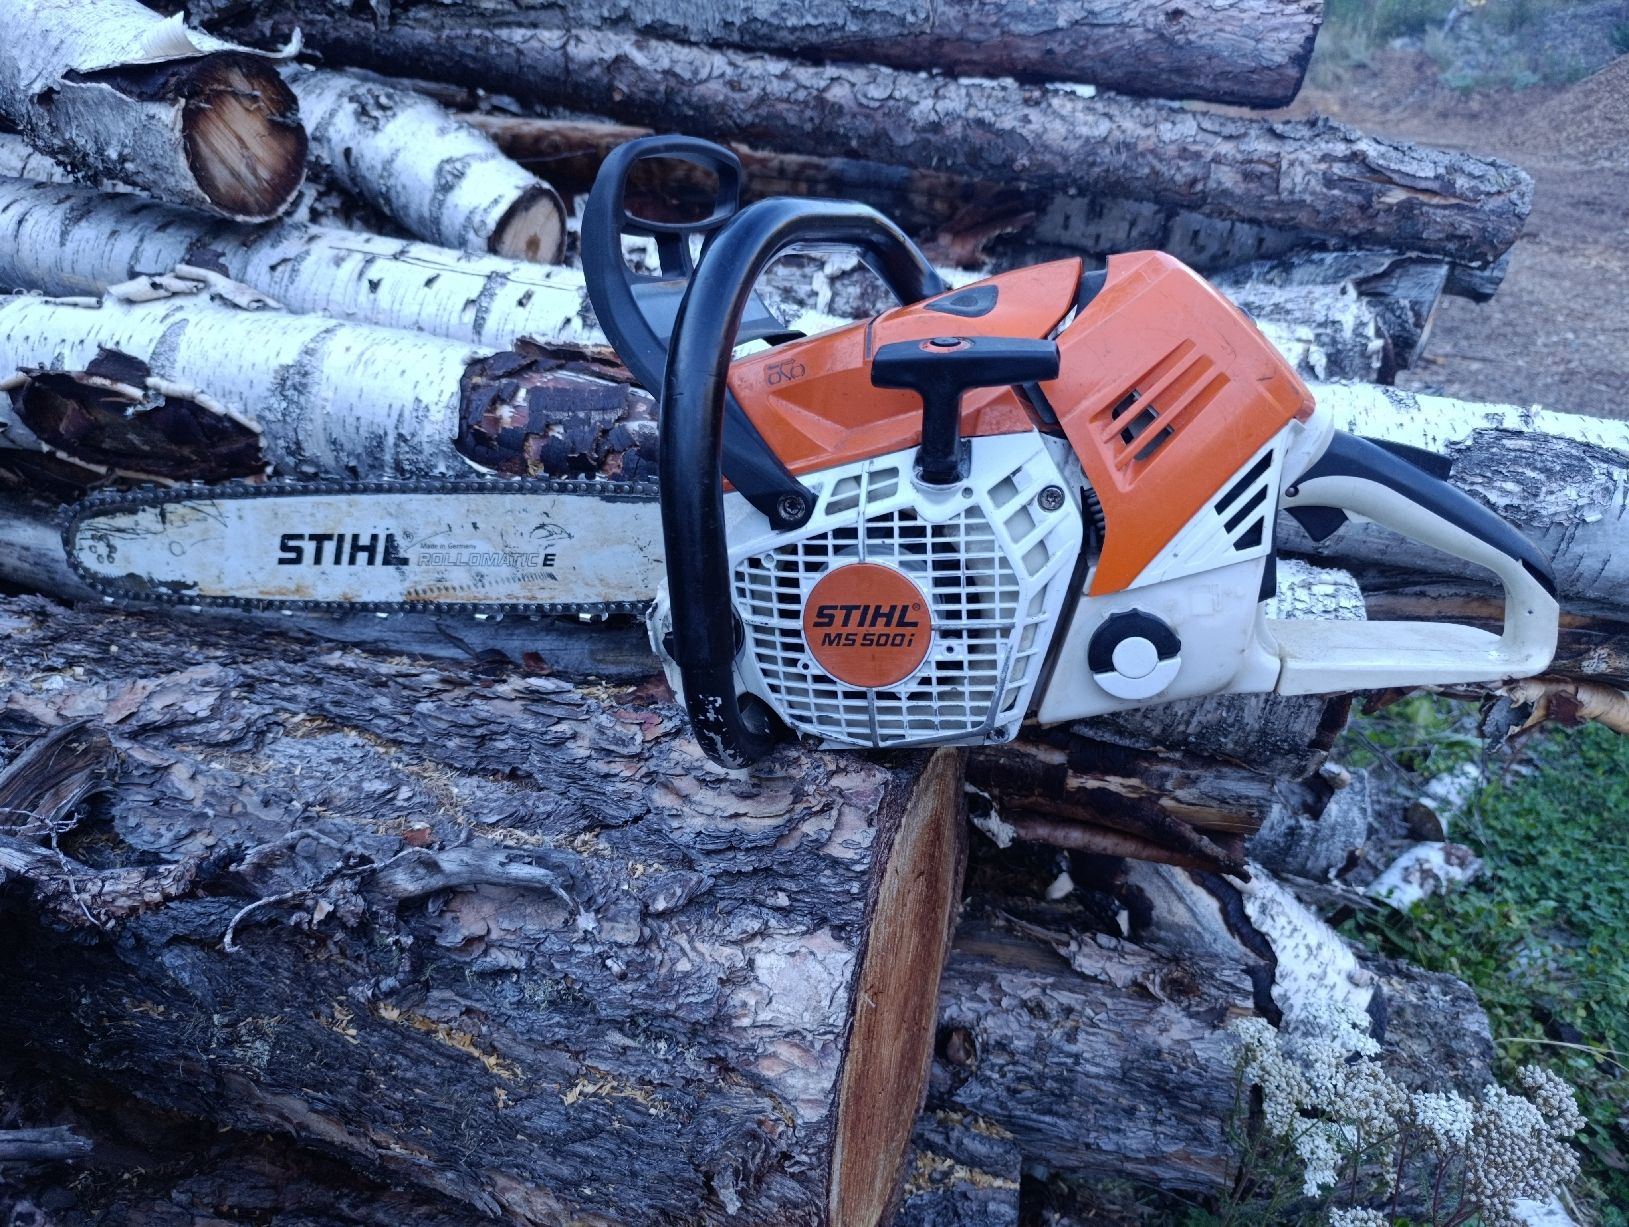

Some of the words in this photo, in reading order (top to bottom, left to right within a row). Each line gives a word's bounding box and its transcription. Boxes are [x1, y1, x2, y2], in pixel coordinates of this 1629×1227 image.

[277, 533, 410, 567] STIHL
[416, 552, 540, 568] ROLLOMATIC
[542, 553, 557, 567] E
[812, 604, 919, 628] STIHL
[821, 633, 858, 647] MS
[860, 633, 915, 648] 500i
